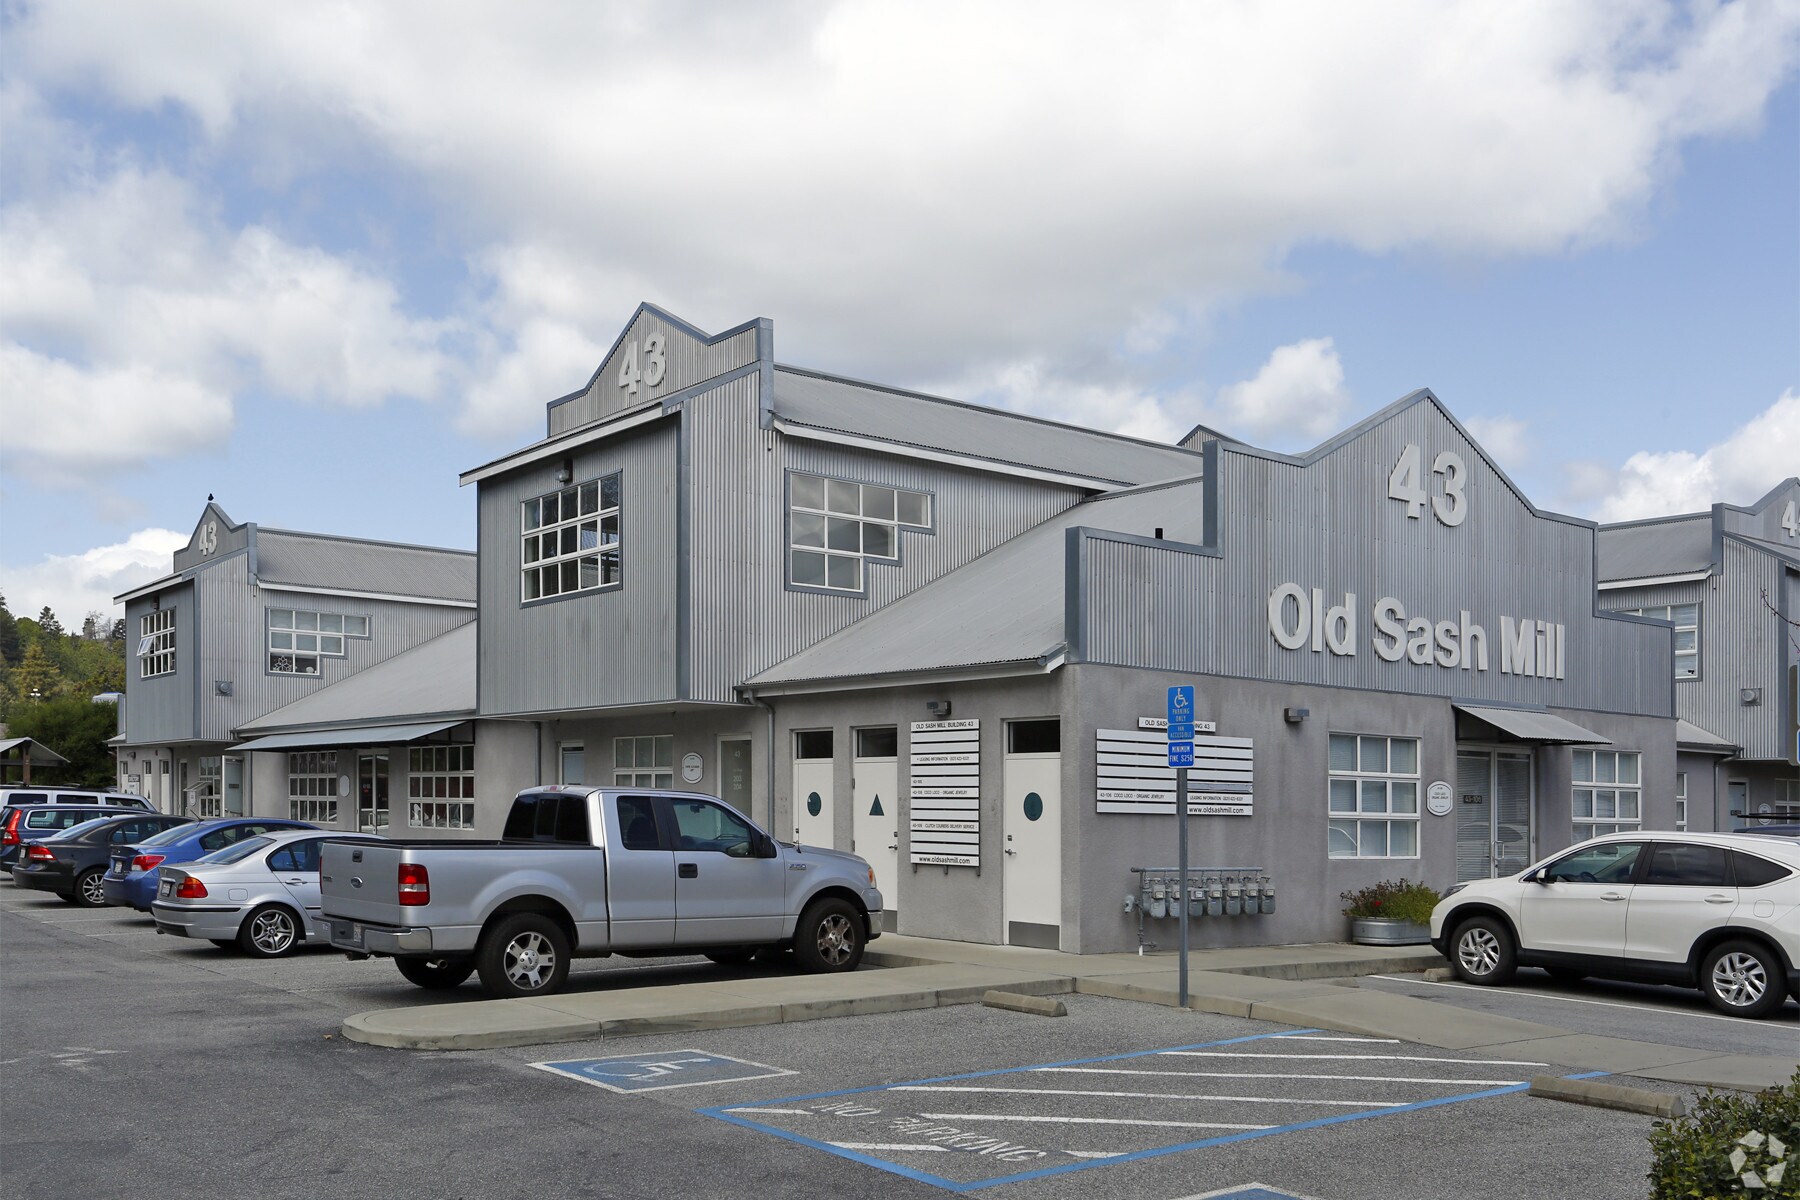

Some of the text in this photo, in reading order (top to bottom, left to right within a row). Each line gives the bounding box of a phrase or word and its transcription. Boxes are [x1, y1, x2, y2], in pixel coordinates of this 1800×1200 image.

[618, 332, 666, 394] 43
[1388, 444, 1467, 526] 43
[199, 520, 217, 556] 43
[1782, 500, 1800, 537] 4
[1268, 582, 1565, 680] Old Sash Mill
[811, 1102, 1048, 1162] NO PARKING
